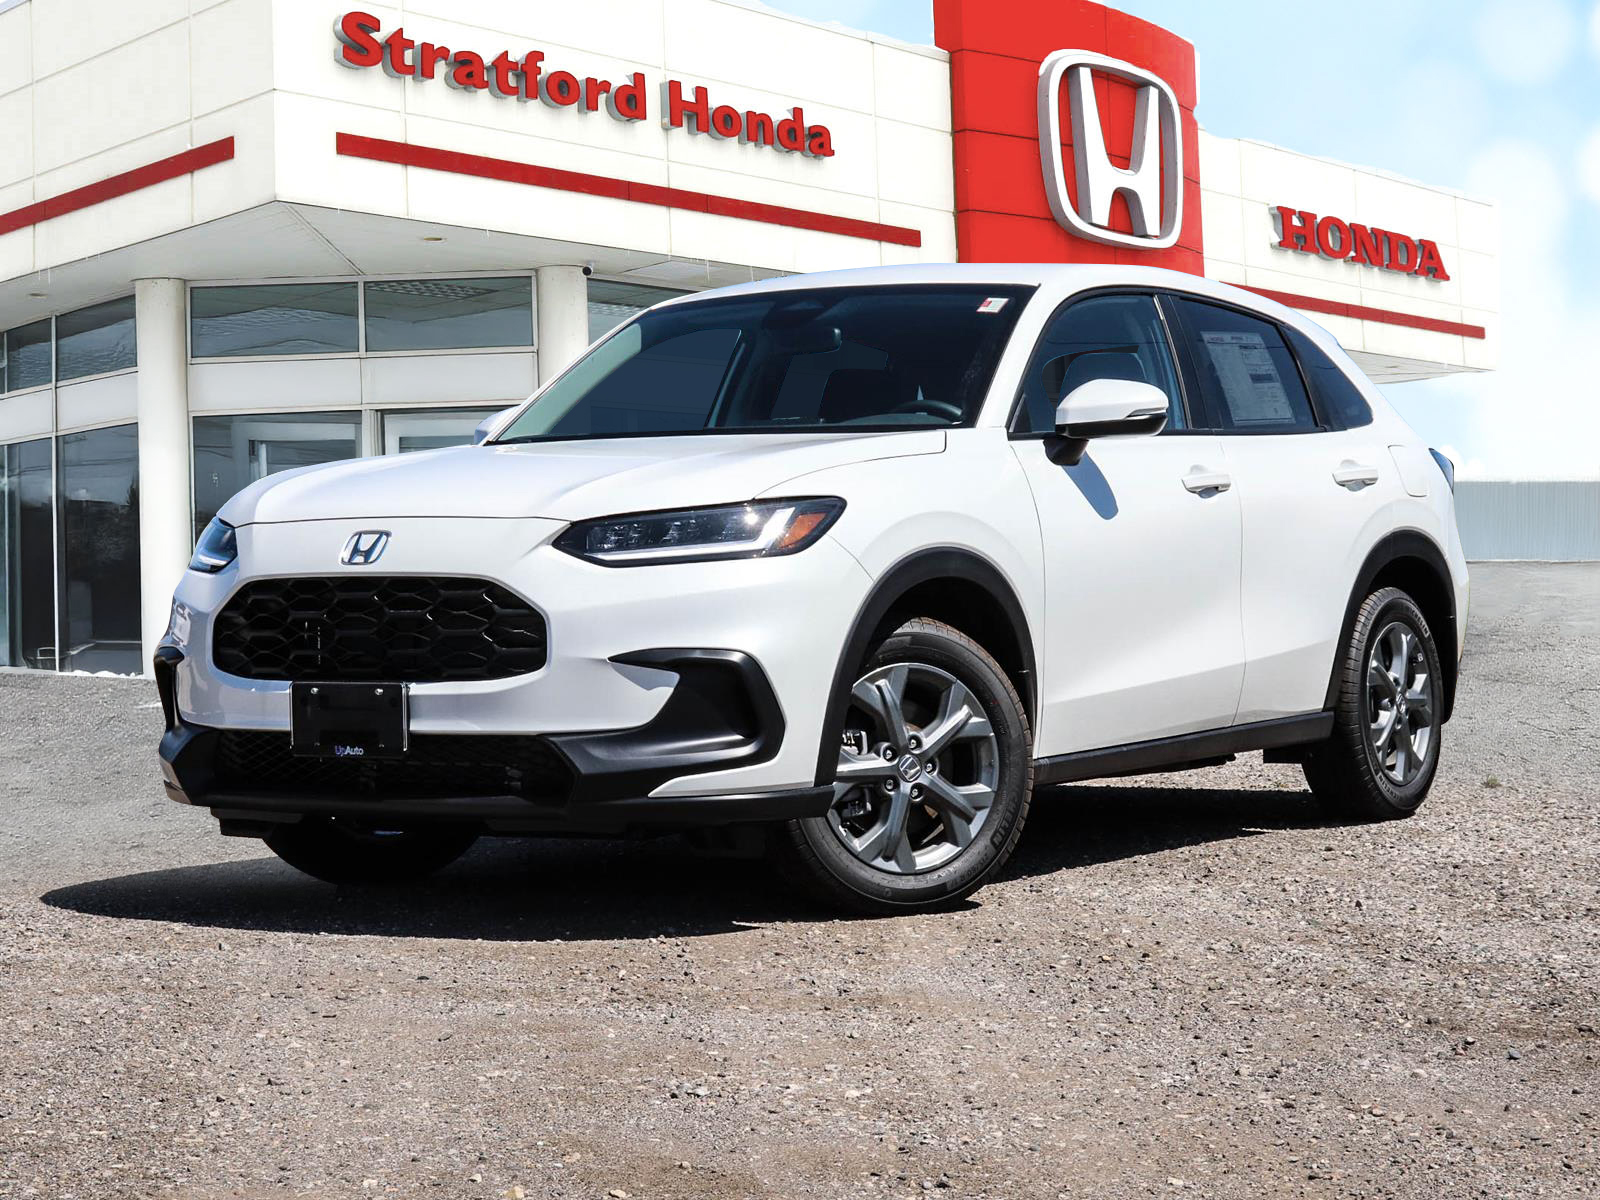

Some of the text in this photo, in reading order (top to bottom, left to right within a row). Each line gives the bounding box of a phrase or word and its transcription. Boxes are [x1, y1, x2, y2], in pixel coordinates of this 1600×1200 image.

[337, 12, 835, 157] Stratford Honda
[1271, 206, 1450, 281] HONDA
[334, 745, 364, 757] UpAuto
